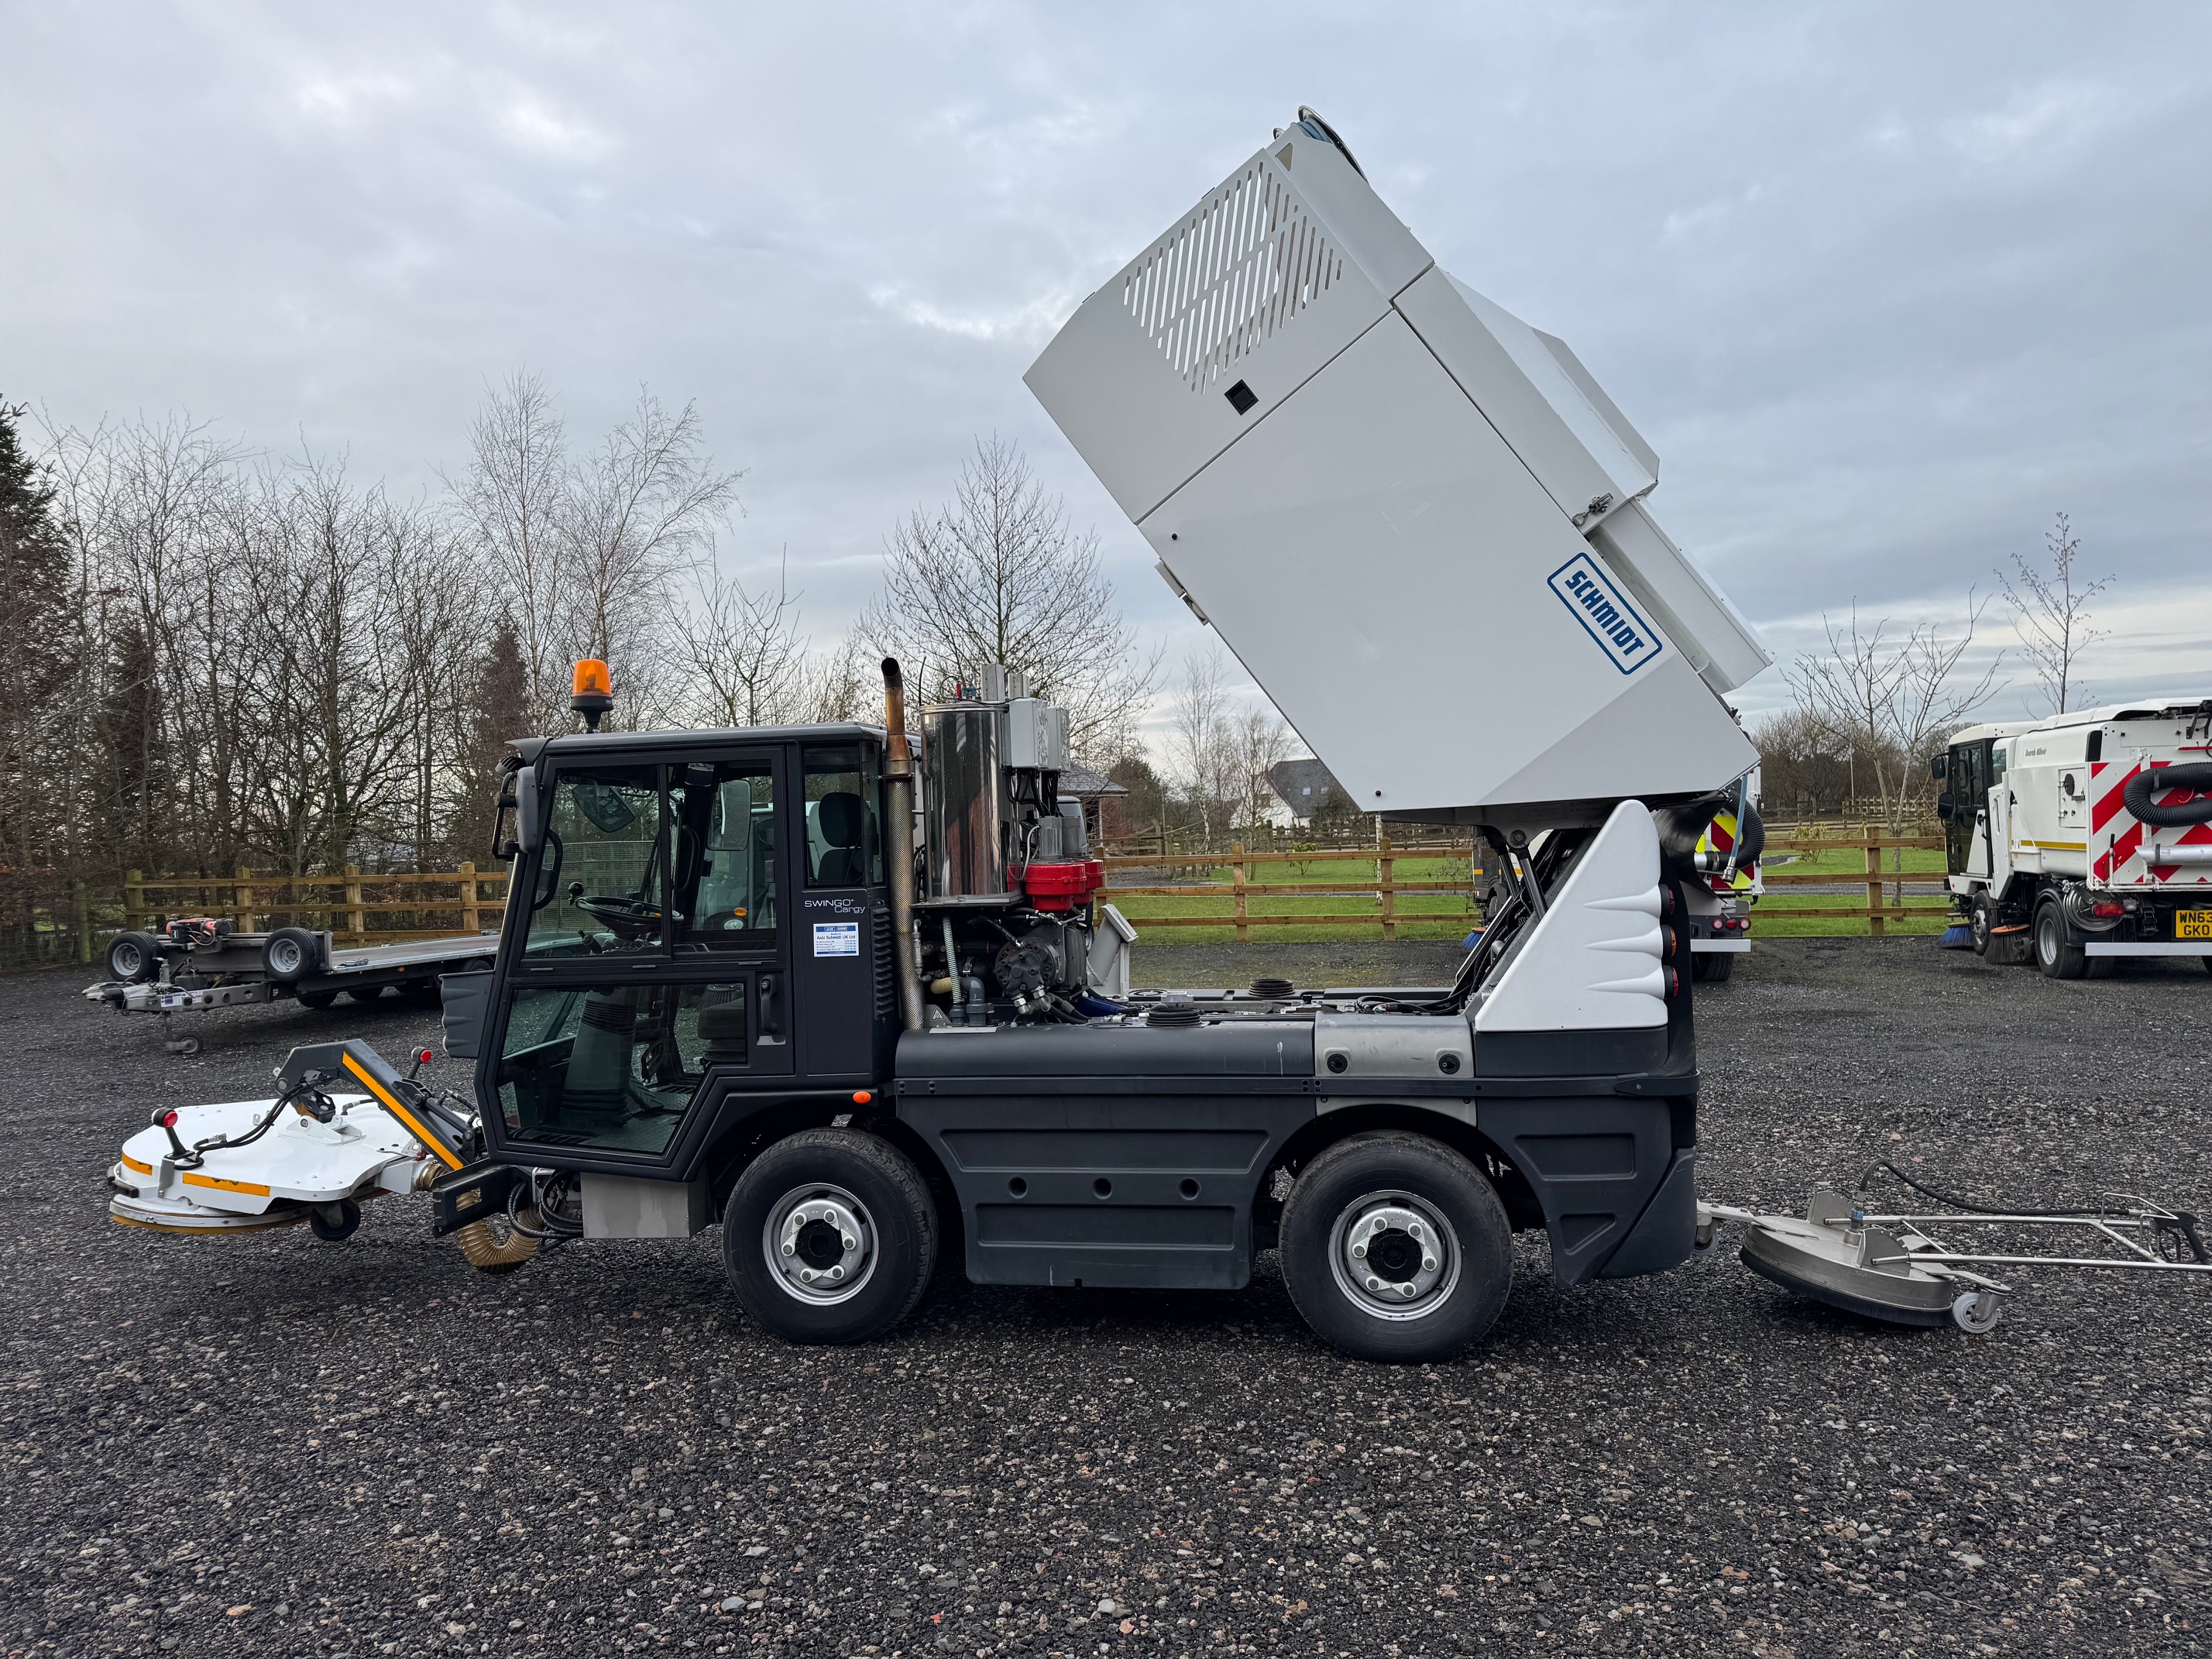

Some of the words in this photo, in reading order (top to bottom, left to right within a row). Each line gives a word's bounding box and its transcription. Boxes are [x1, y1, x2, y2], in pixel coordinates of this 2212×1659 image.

[1565, 570, 1645, 656] SCHMIDT
[834, 905, 866, 914] Cargy
[2179, 912, 2212, 923] WN63
[2184, 925, 2210, 936] GKO
